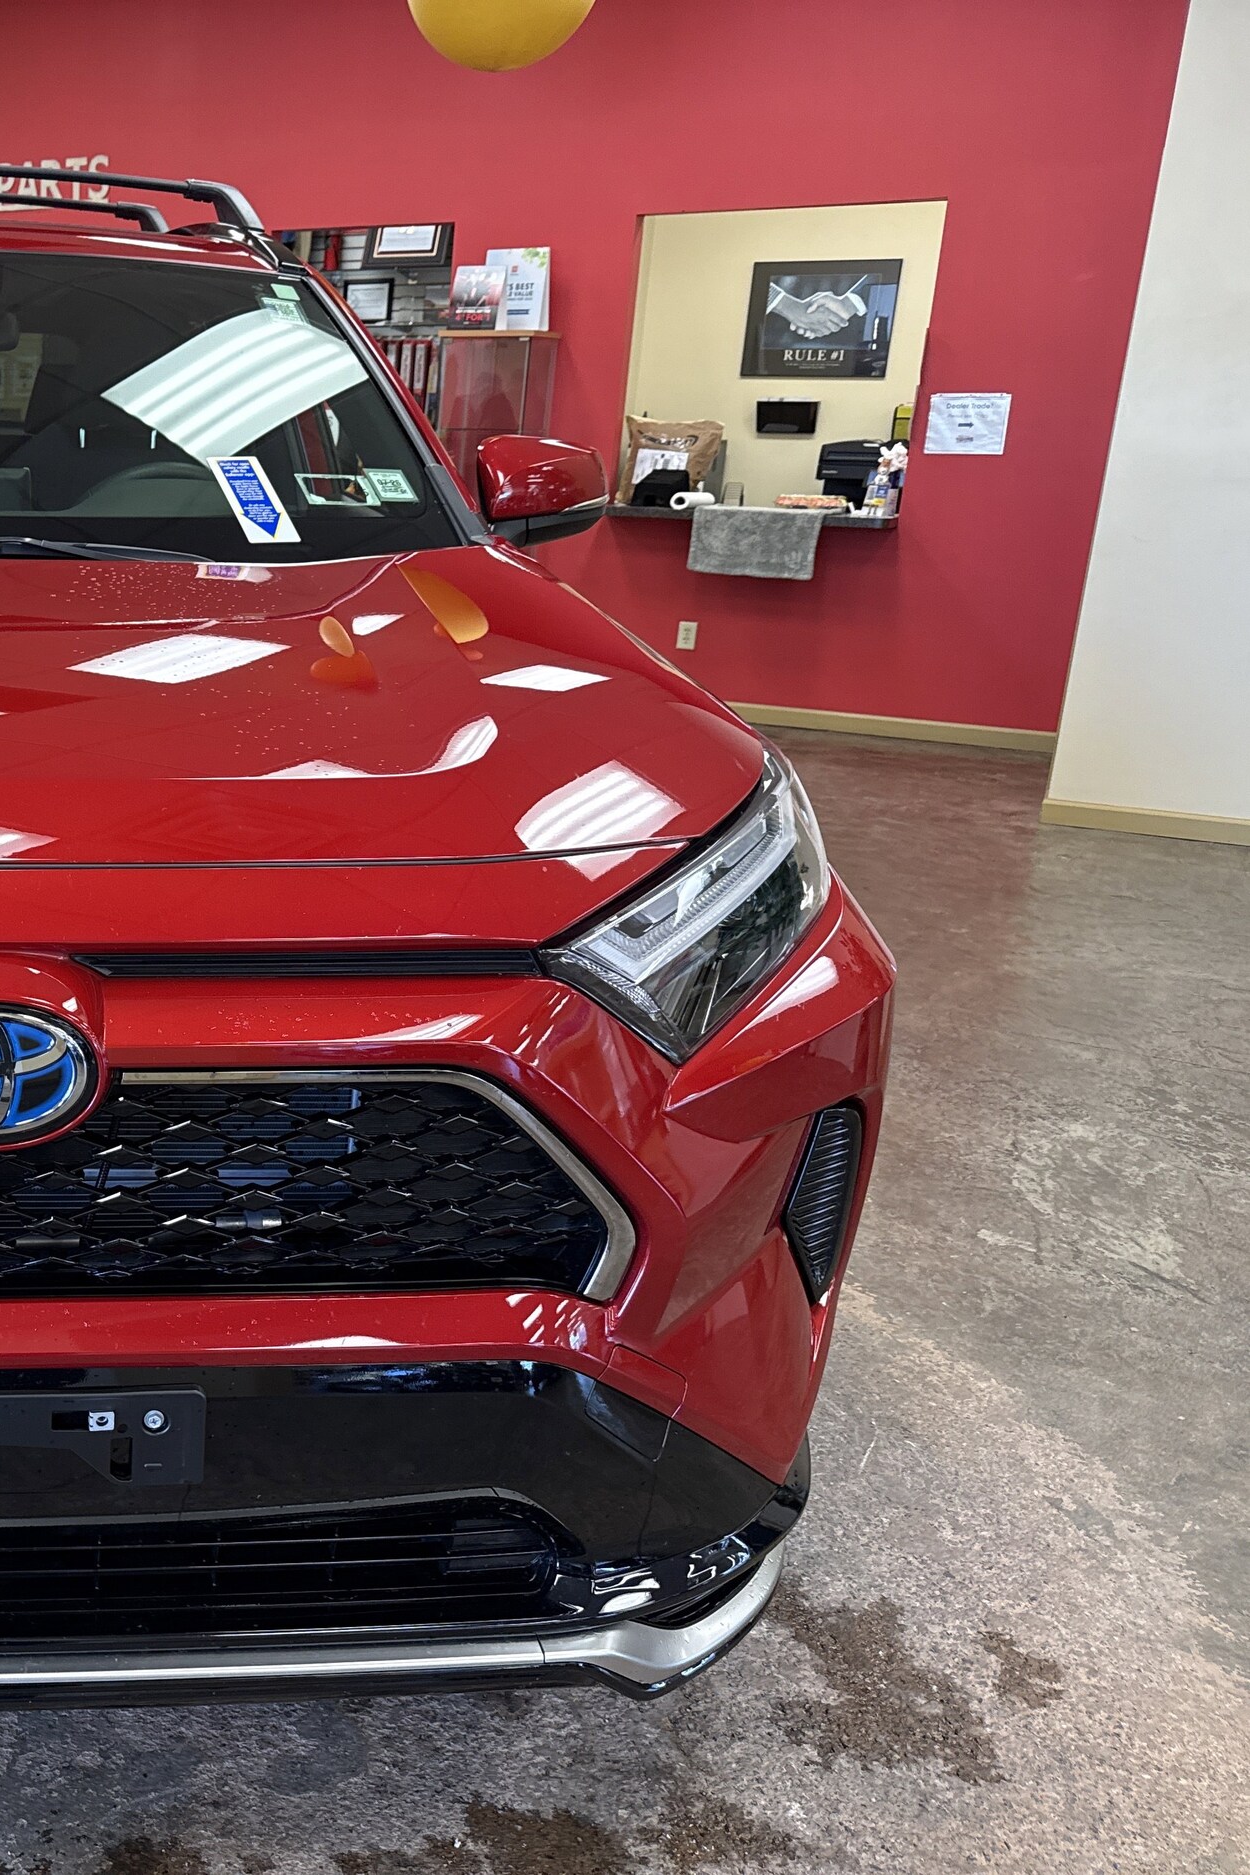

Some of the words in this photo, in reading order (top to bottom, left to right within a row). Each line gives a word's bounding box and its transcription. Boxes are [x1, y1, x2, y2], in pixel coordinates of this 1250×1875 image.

[515, 282, 535, 291] BEST
[466, 313, 483, 321] FOR
[783, 349, 827, 361] RULE
[830, 349, 845, 361] #1
[946, 402, 969, 410] Dealer
